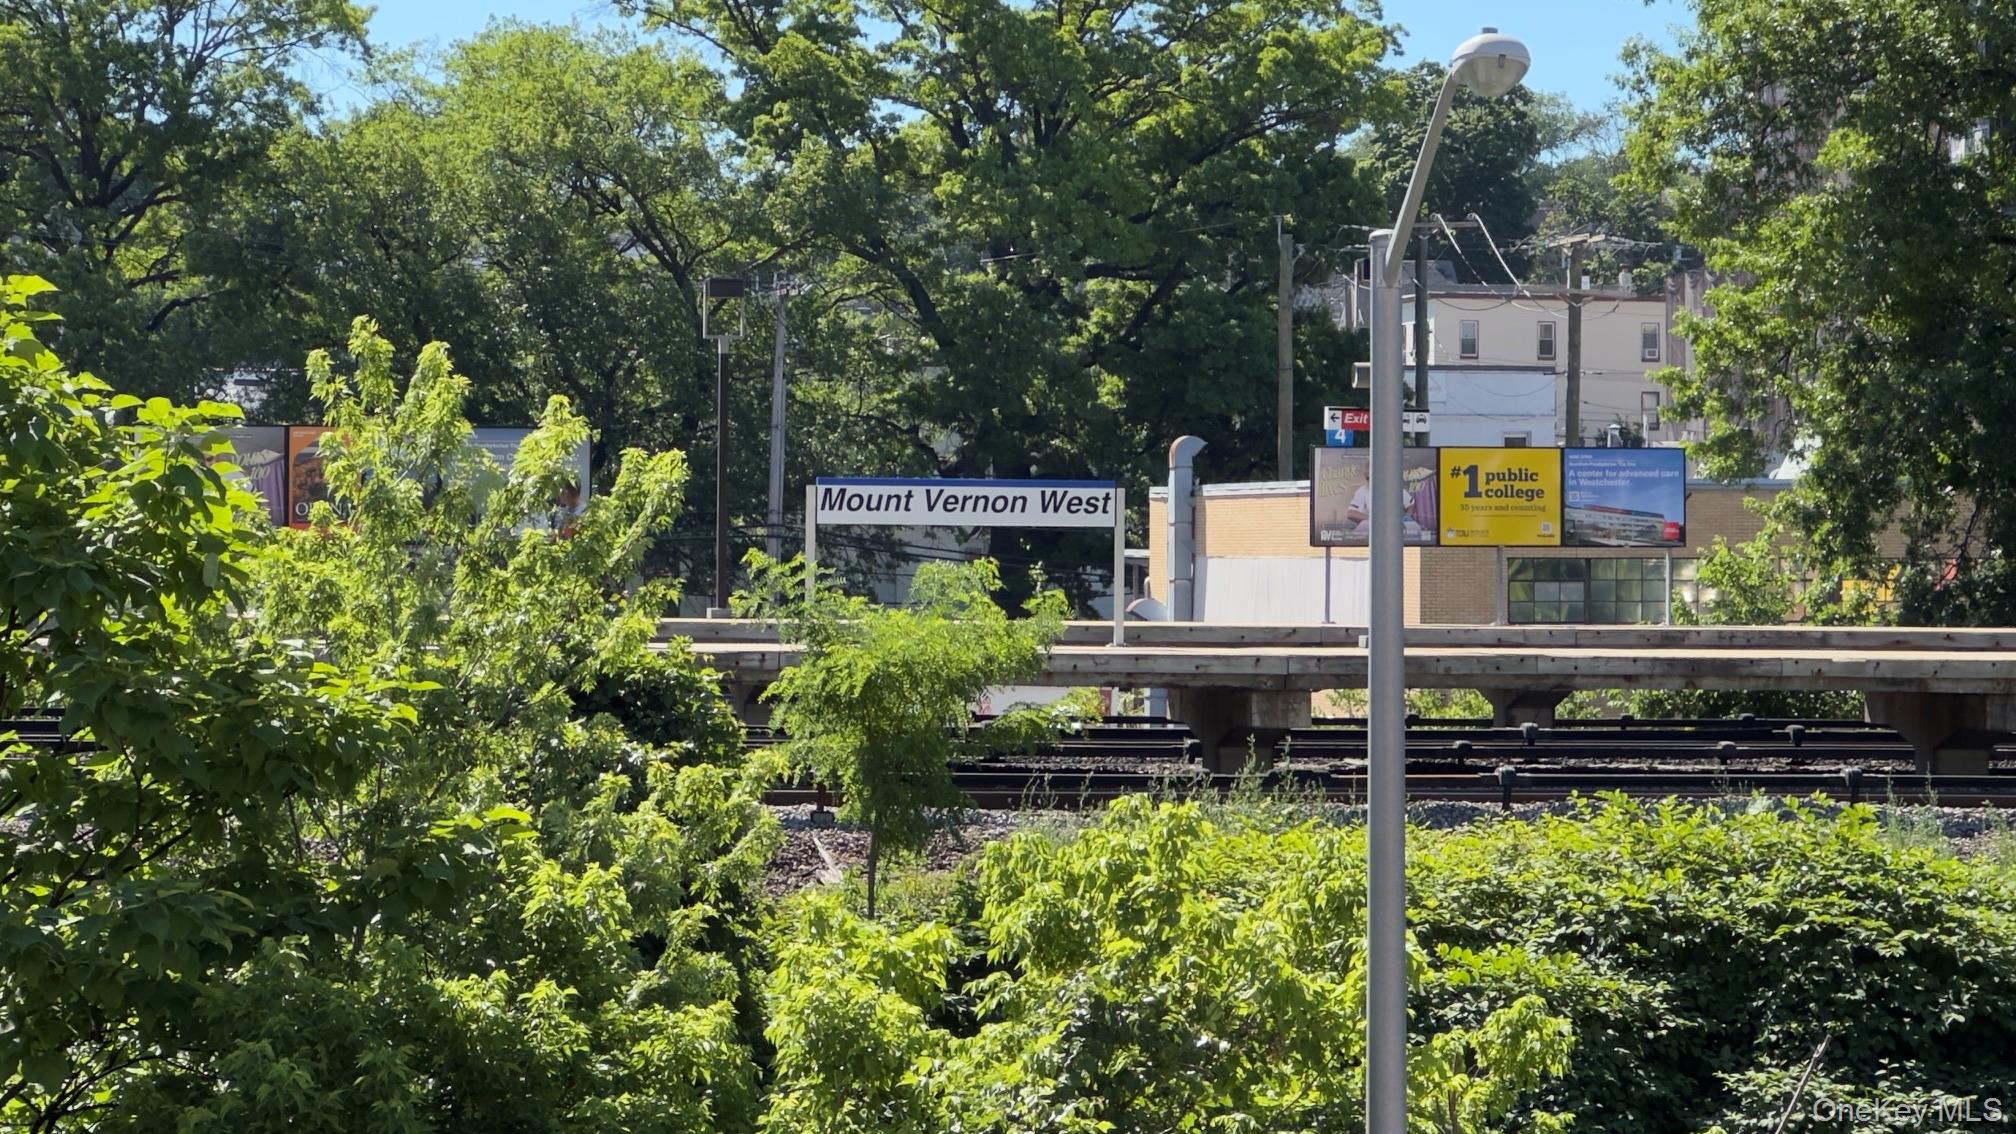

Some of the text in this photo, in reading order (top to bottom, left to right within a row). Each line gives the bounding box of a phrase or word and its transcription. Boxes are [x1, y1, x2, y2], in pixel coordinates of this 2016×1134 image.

[1344, 413, 1368, 424] Exit
[1334, 429, 1346, 443] 4
[1485, 468, 1539, 485] public
[820, 487, 1113, 514] Mount Vernon West
[1485, 484, 1545, 502] college
[1471, 505, 1492, 513] years
[1510, 504, 1546, 513] counting
